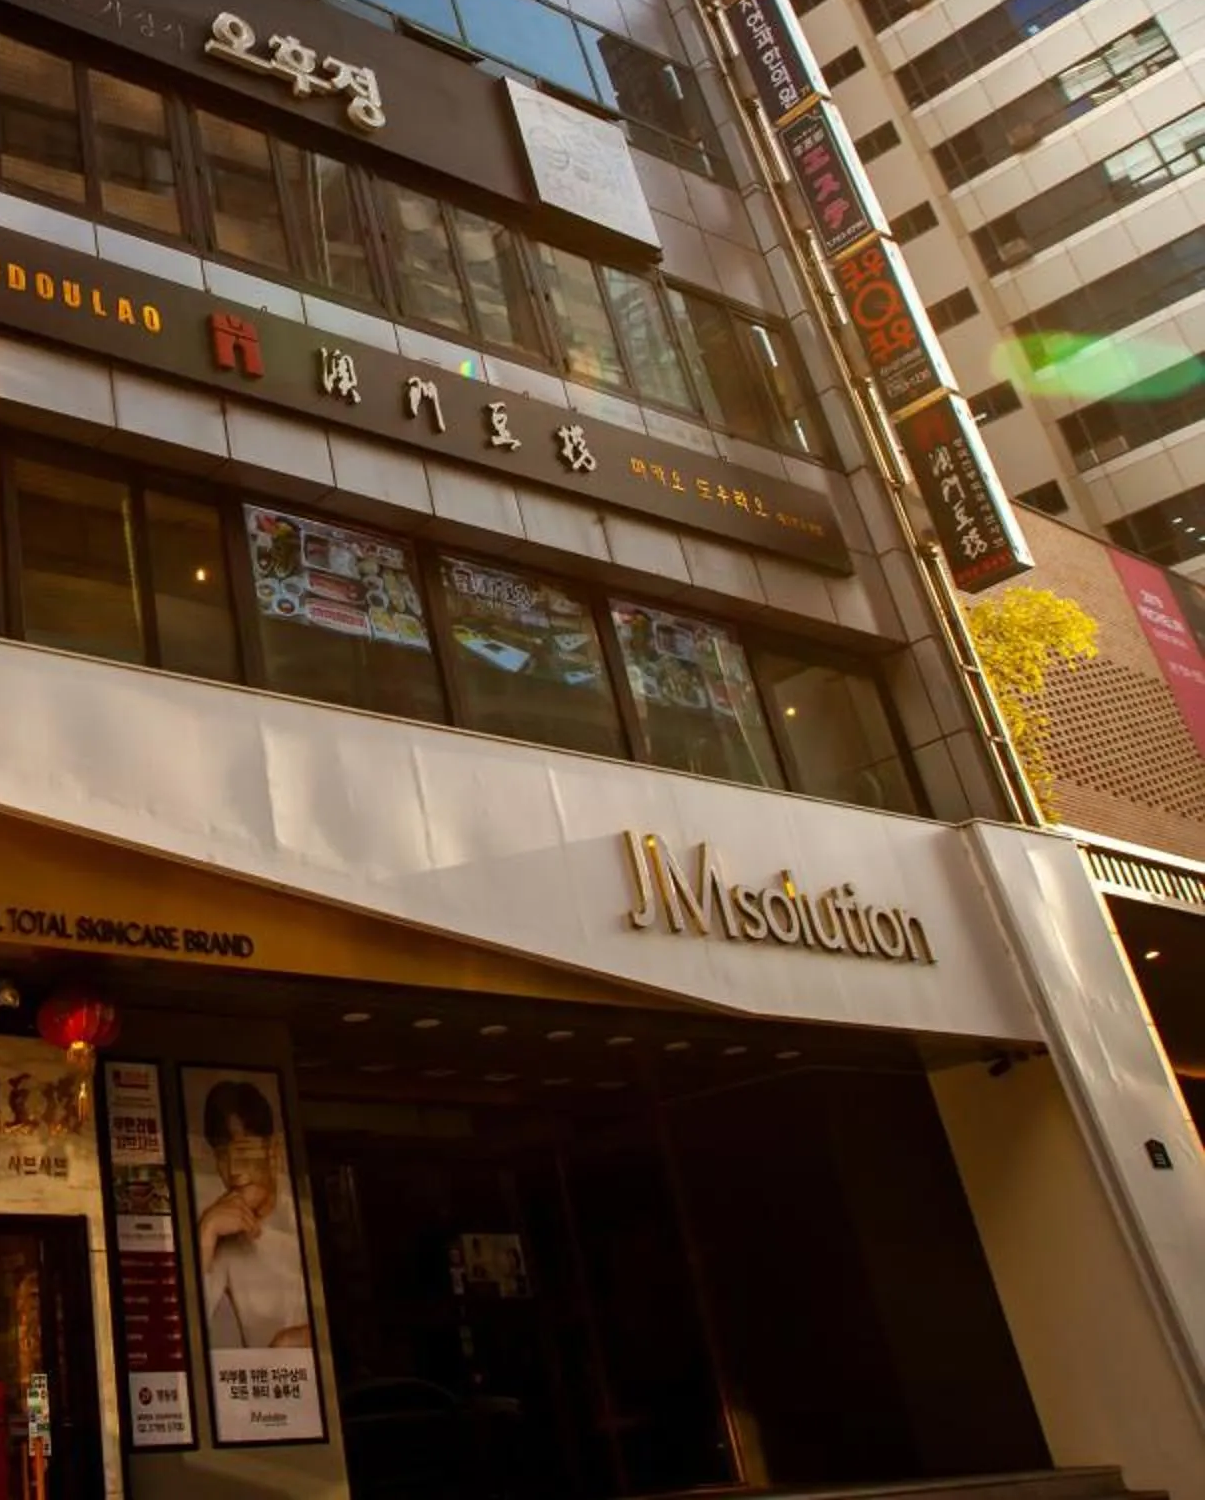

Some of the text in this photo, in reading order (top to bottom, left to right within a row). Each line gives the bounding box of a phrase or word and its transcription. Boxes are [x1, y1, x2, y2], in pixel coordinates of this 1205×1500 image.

[205, 11, 386, 131] 오후정
[629, 456, 685, 493] 마카오
[8, 907, 73, 940] TOTAL
[76, 916, 179, 951] SKINCARE
[184, 929, 255, 959] BRAND
[620, 830, 938, 964] JMsolution
